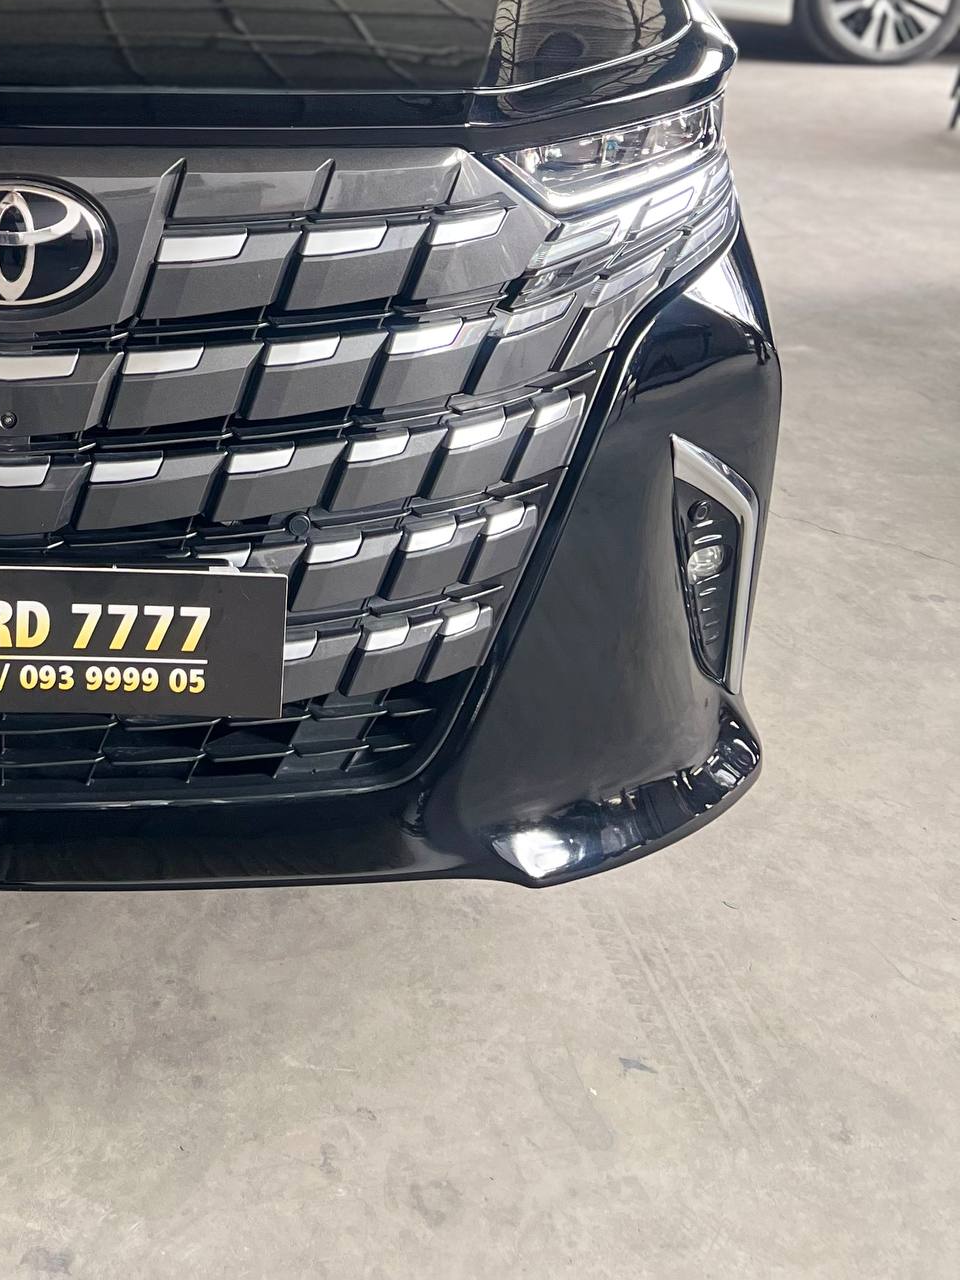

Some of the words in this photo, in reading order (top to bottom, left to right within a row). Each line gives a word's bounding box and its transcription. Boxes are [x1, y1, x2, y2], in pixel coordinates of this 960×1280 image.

[71, 603, 211, 652] 7777
[19, 664, 75, 691] 093
[84, 665, 160, 693] 9999
[168, 667, 206, 694] 05
